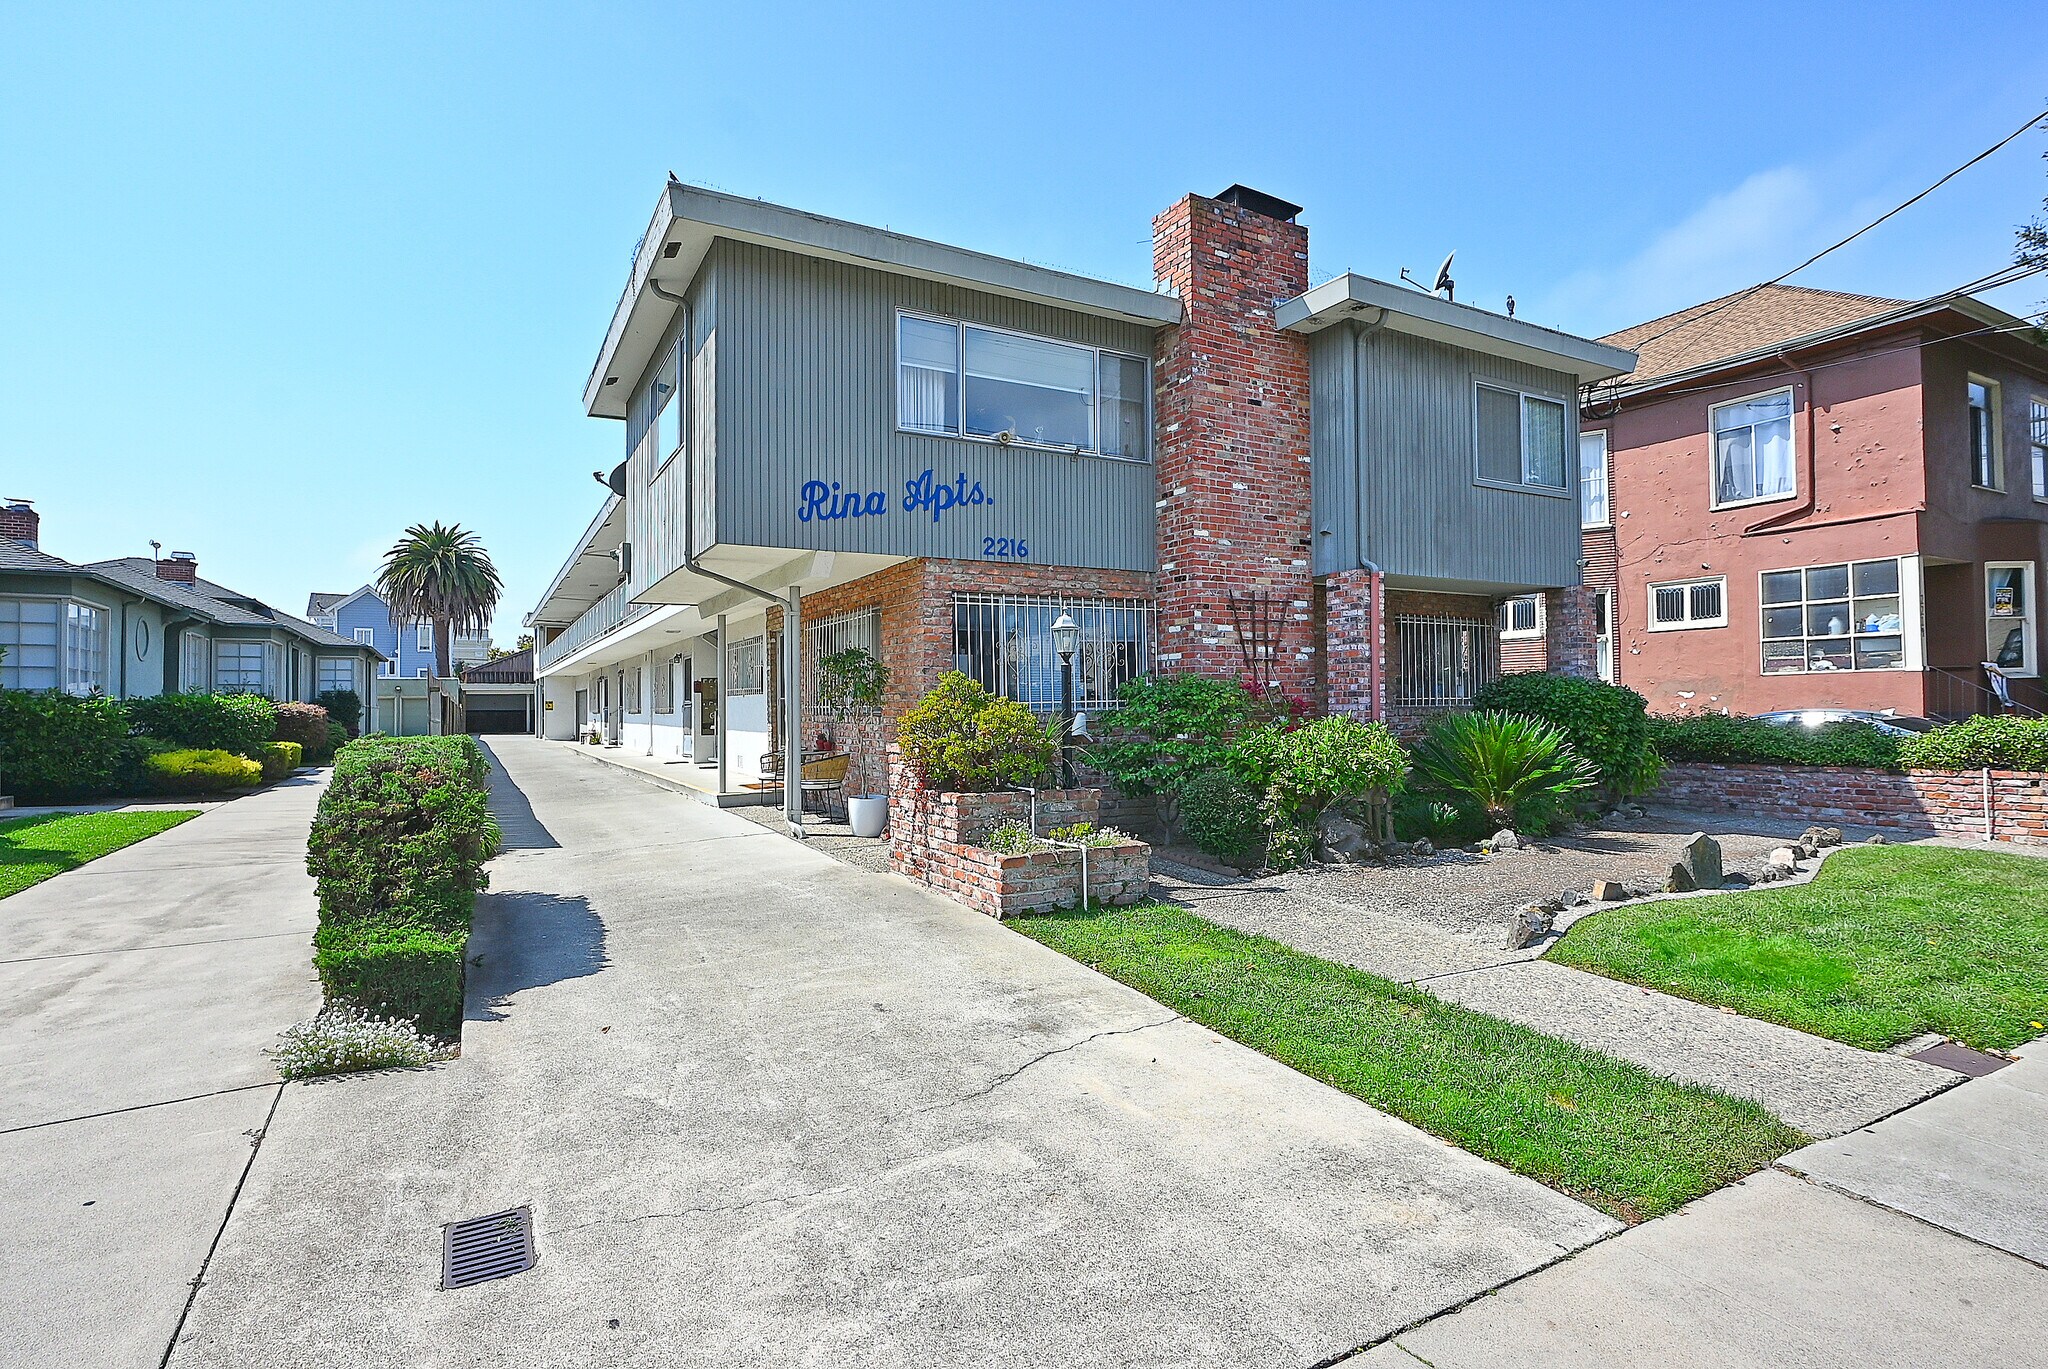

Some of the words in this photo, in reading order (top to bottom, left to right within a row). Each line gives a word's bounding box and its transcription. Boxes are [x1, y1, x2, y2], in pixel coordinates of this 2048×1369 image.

[797, 480, 887, 523] Rina
[902, 469, 994, 523] Apts.
[982, 536, 1029, 558] 2216
